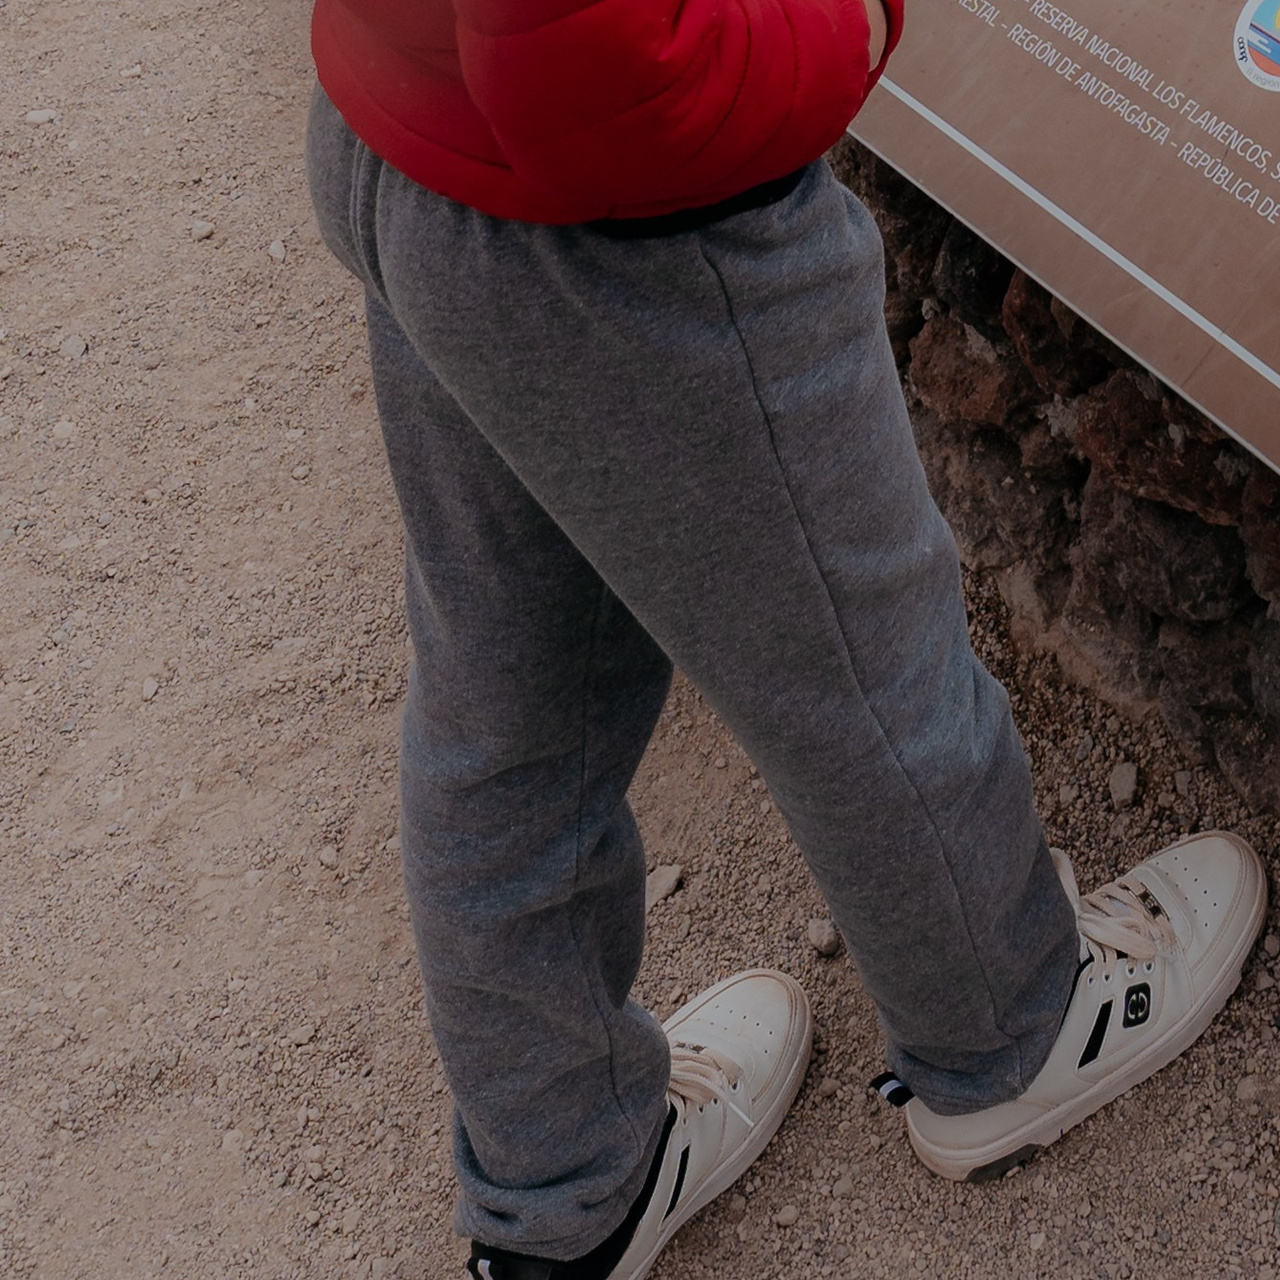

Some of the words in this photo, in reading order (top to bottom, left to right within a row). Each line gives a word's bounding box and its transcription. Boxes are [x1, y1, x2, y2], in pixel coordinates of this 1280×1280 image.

[1007, 23, 1062, 67] REGIÓN
[1055, 56, 1081, 82] DE
[1074, 72, 1171, 146] ANTOFAGASTA
[1177, 141, 1260, 208] REPÚBLICA
[1085, 34, 1155, 92] NACIONAL
[1152, 80, 1186, 109] LOS
[1180, 99, 1273, 174] FLAMENCOS,
[1253, 72, 1280, 88] región
